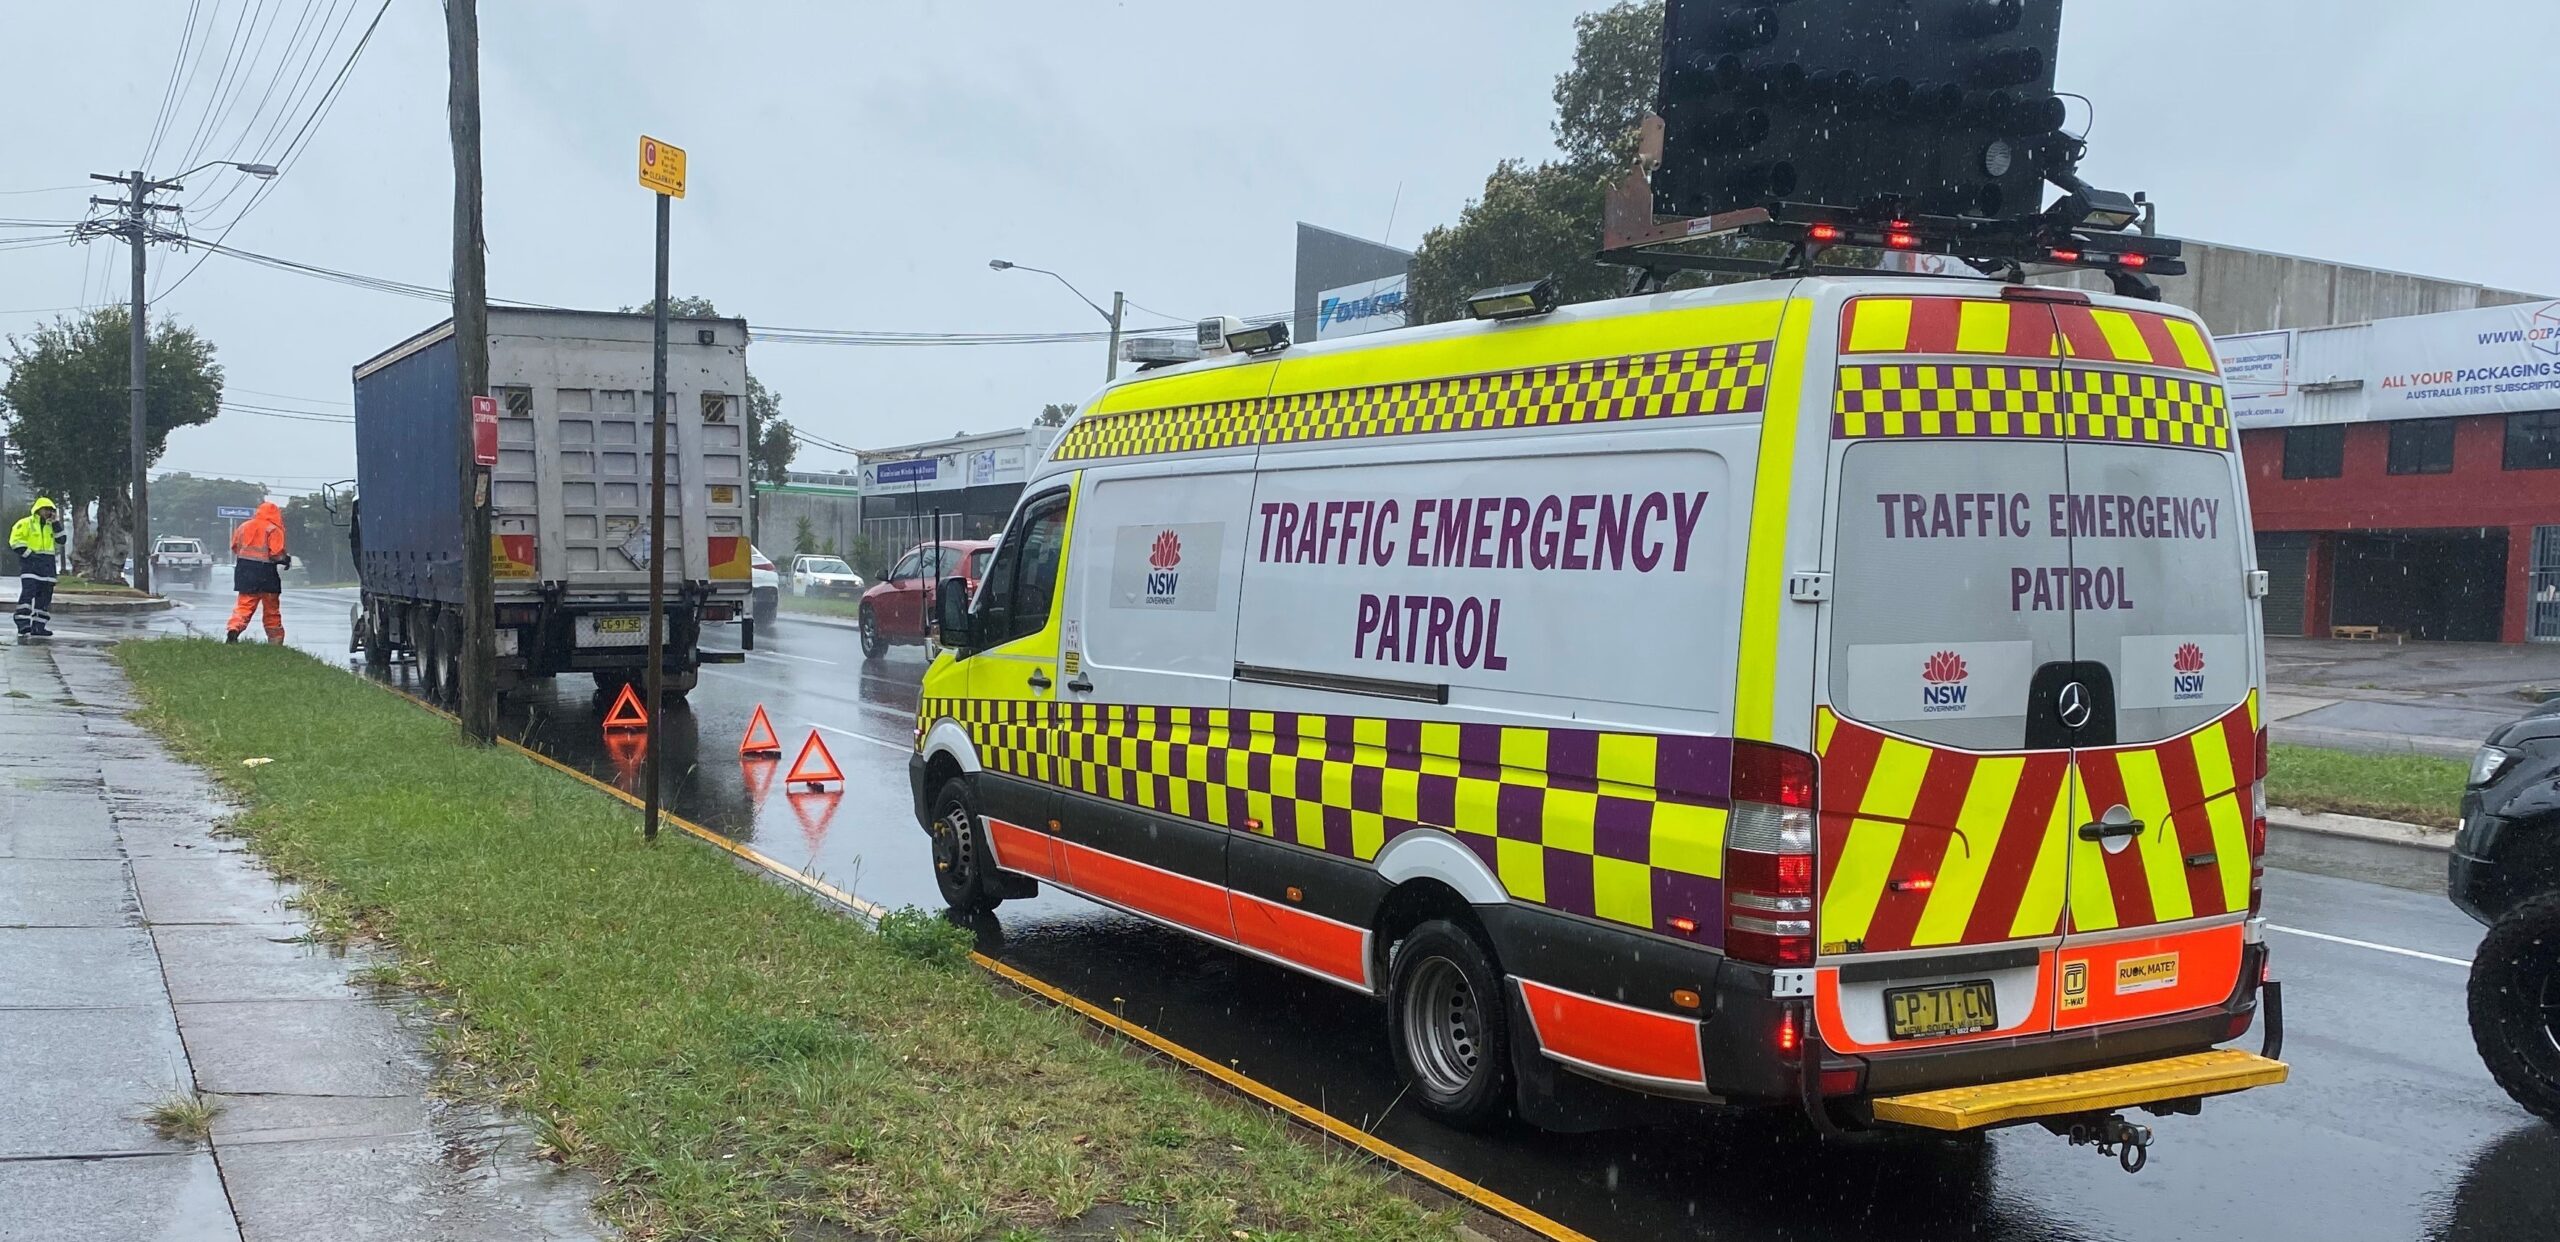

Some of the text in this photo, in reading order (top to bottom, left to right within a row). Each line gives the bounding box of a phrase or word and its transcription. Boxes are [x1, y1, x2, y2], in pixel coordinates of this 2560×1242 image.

[2382, 375, 2407, 389] ALL
[2411, 371, 2453, 386] YOUR
[2456, 363, 2551, 382] PACKAGING
[2406, 387, 2462, 400] AUSTRALIA
[2464, 385, 2492, 396] FIRST
[480, 400, 491, 412] NO
[1877, 493, 2219, 540] TRAFFIC EMERGENCY
[1259, 491, 1709, 573] TRAFFIC EMERGENCY
[1146, 573, 1178, 595] NSW
[2011, 567, 2134, 611] PATROL
[1145, 596, 1176, 605] GOVERNMENT
[1354, 594, 1508, 672] PATROL
[2174, 675, 2205, 693] NSW
[1924, 685, 1968, 705] NSW
[2174, 693, 2204, 701] GOVERNMENT
[1923, 704, 1966, 713] GOVERNMENT
[2147, 960, 2176, 975] MATE?
[2064, 996, 2085, 1007] T-WAY
[1903, 1025, 1922, 1034] NEW
[1926, 1022, 1955, 1032] SOUTH
